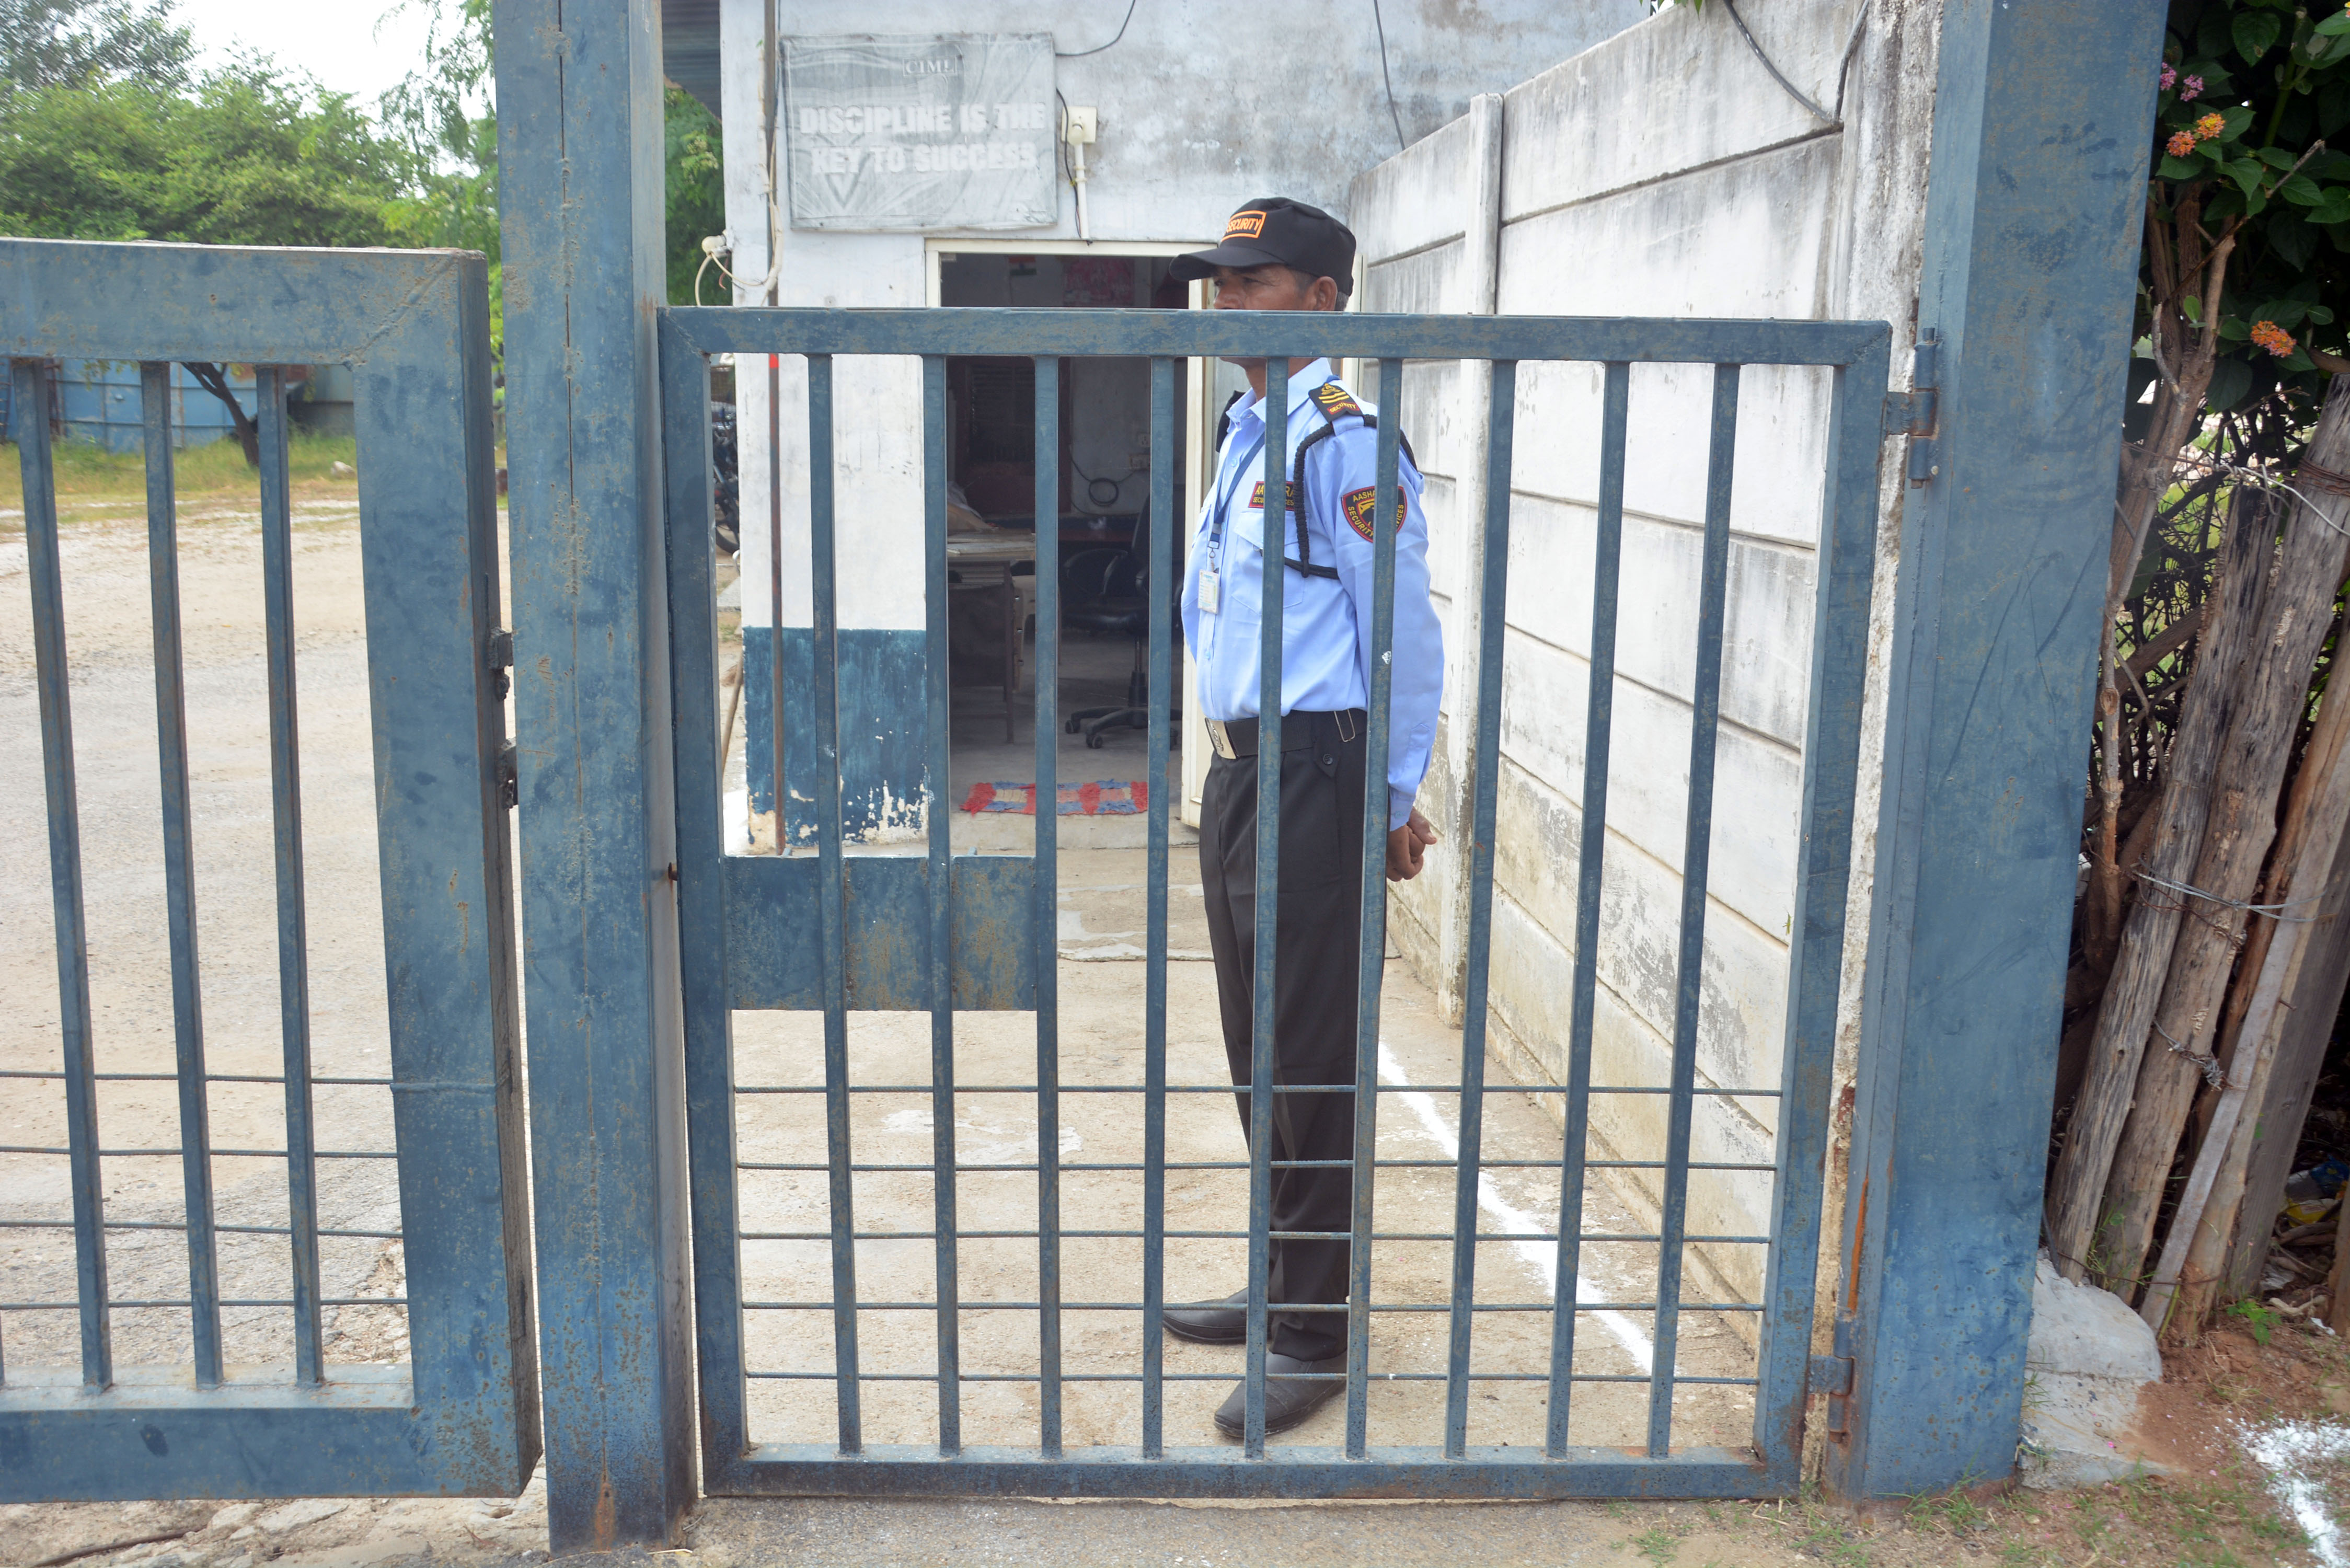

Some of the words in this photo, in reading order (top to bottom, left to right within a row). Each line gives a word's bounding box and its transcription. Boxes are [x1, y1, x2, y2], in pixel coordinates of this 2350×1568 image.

[799, 105, 952, 134] DISCIPLINE
[960, 103, 987, 133] IS
[994, 103, 1045, 129] THE
[811, 145, 862, 174] KEY
[869, 144, 906, 173] TO
[914, 142, 1037, 172] SUCCESS
[1226, 217, 1262, 233] SECURITY
[1329, 402, 1356, 413] SECURITY
[1347, 505, 1374, 537] SECURITY
